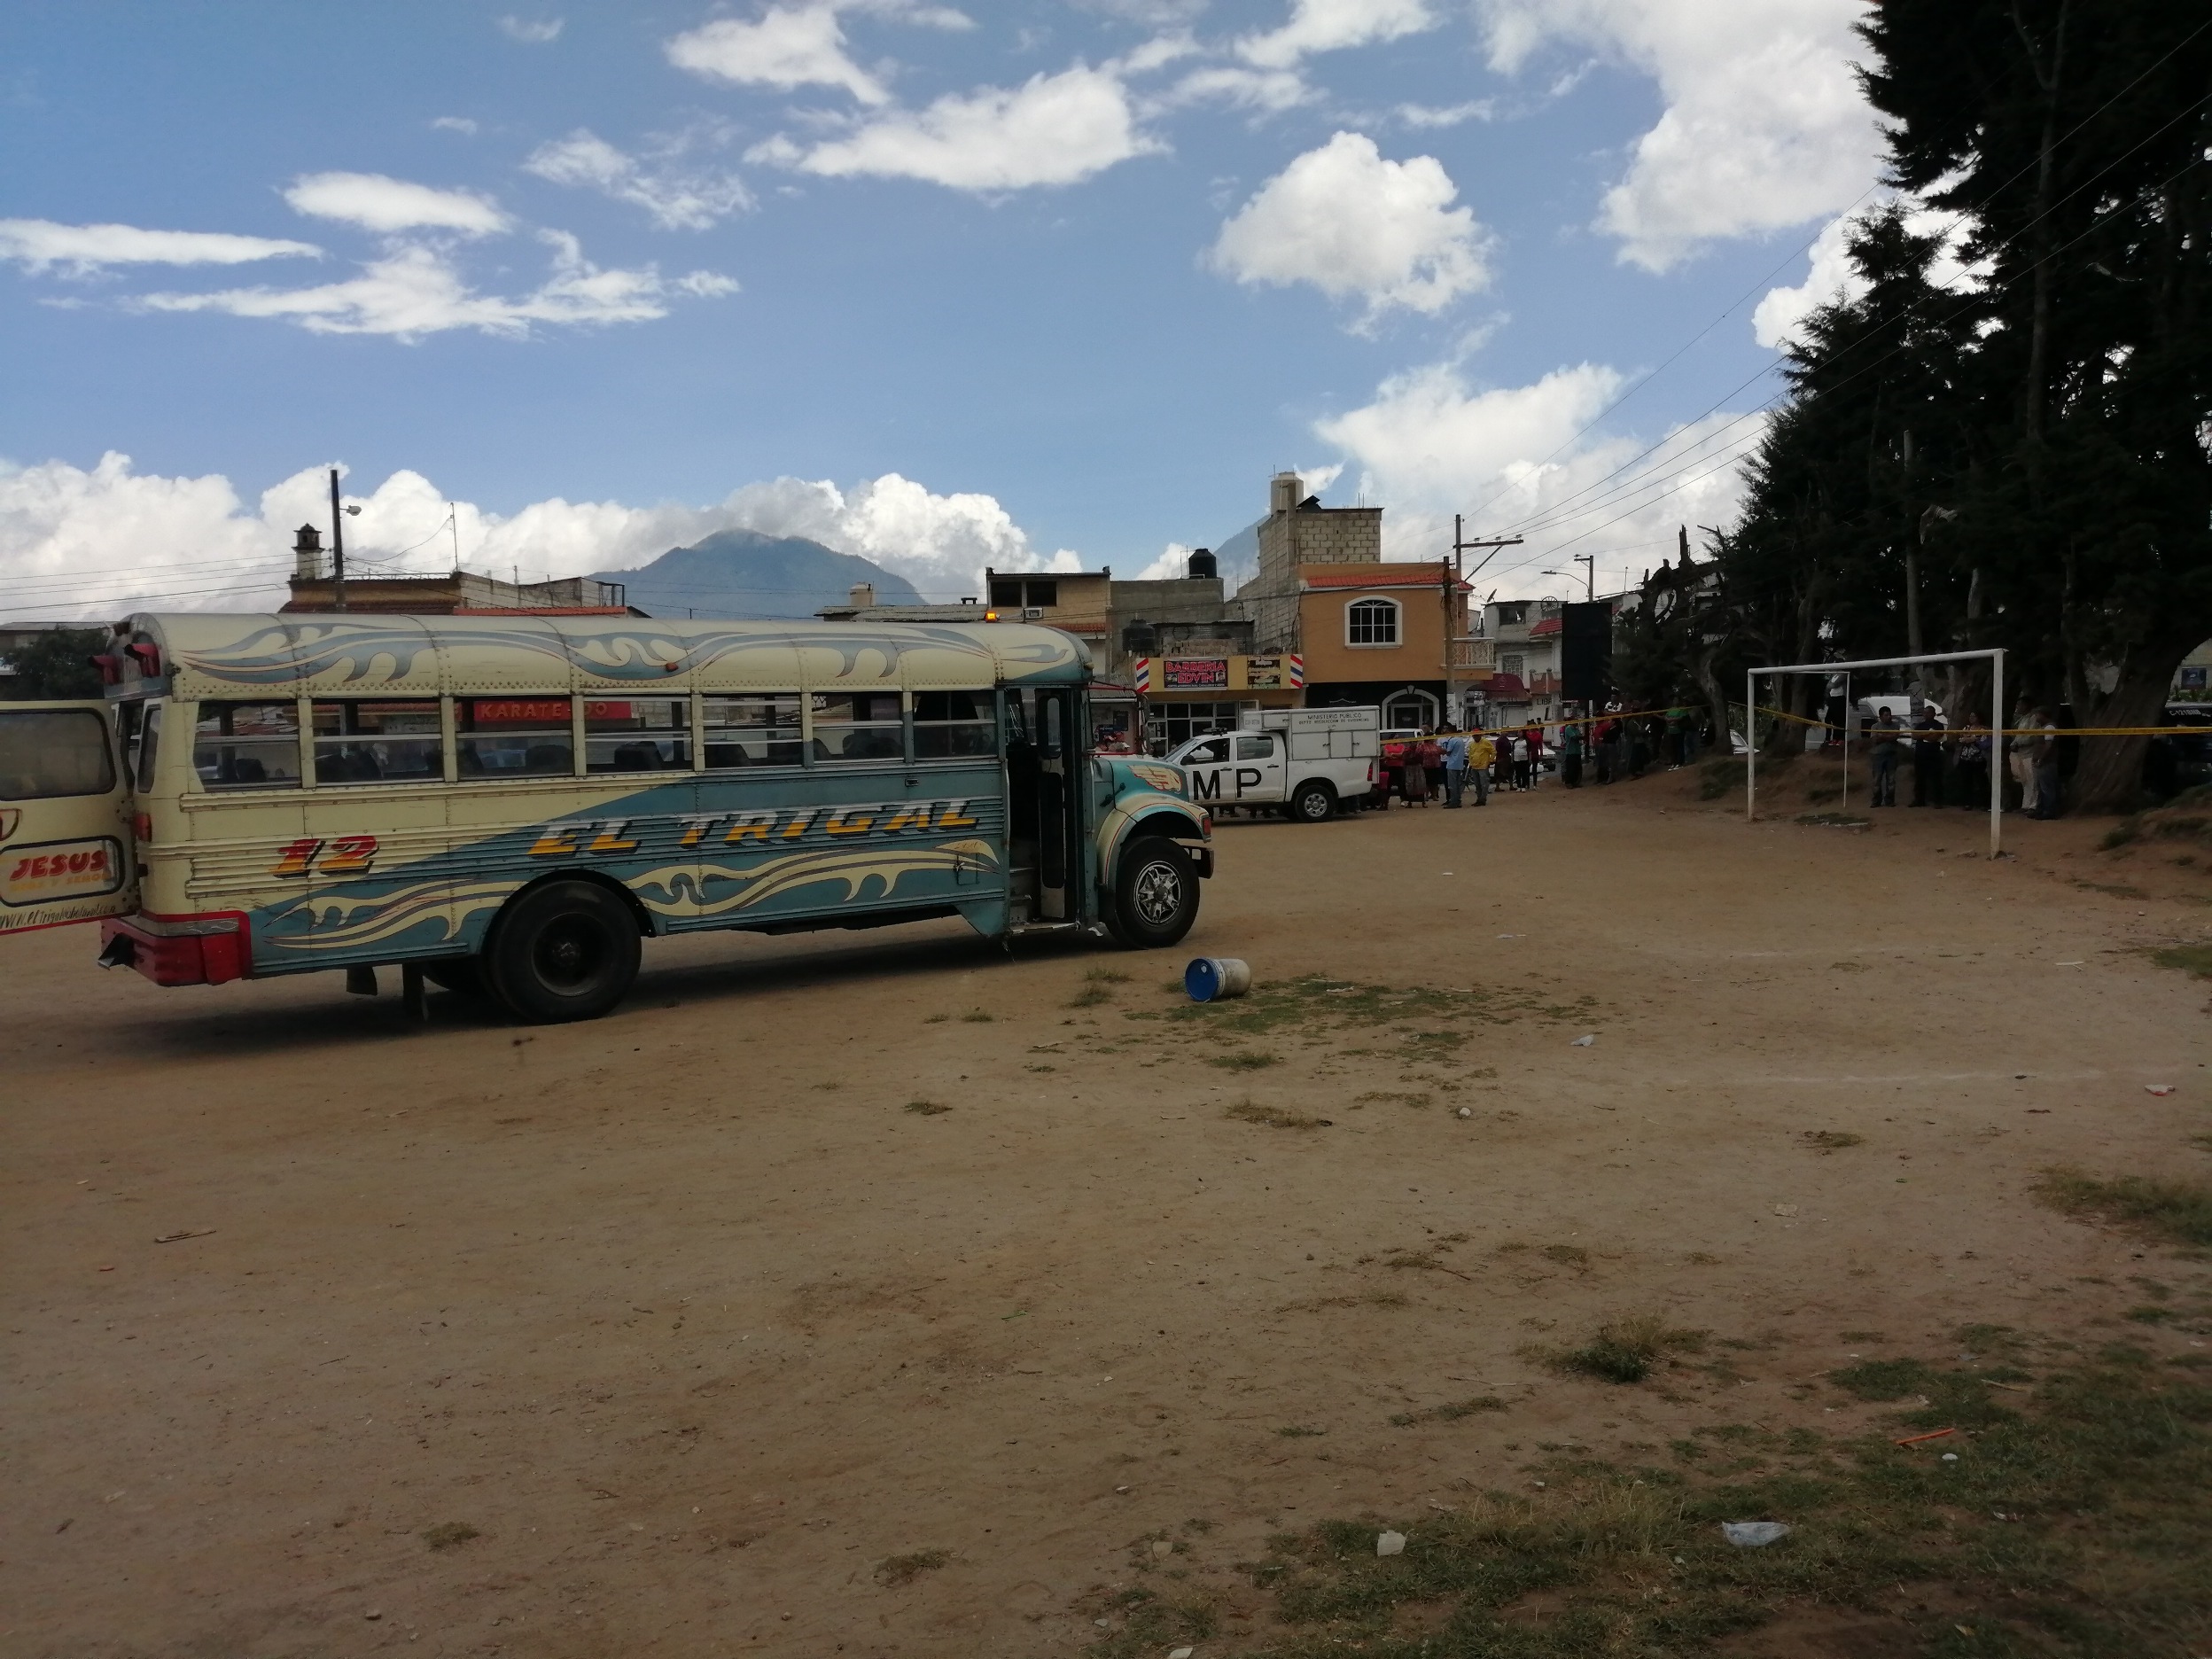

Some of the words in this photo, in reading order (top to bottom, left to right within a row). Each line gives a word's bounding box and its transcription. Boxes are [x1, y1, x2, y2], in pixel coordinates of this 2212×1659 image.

[1165, 661, 1227, 673] BARBERIA
[1177, 672, 1214, 684] EDVIN
[528, 819, 640, 856] EL
[678, 799, 980, 848] TRIGAL
[10, 850, 108, 882] JESUS
[269, 836, 378, 878] 12
